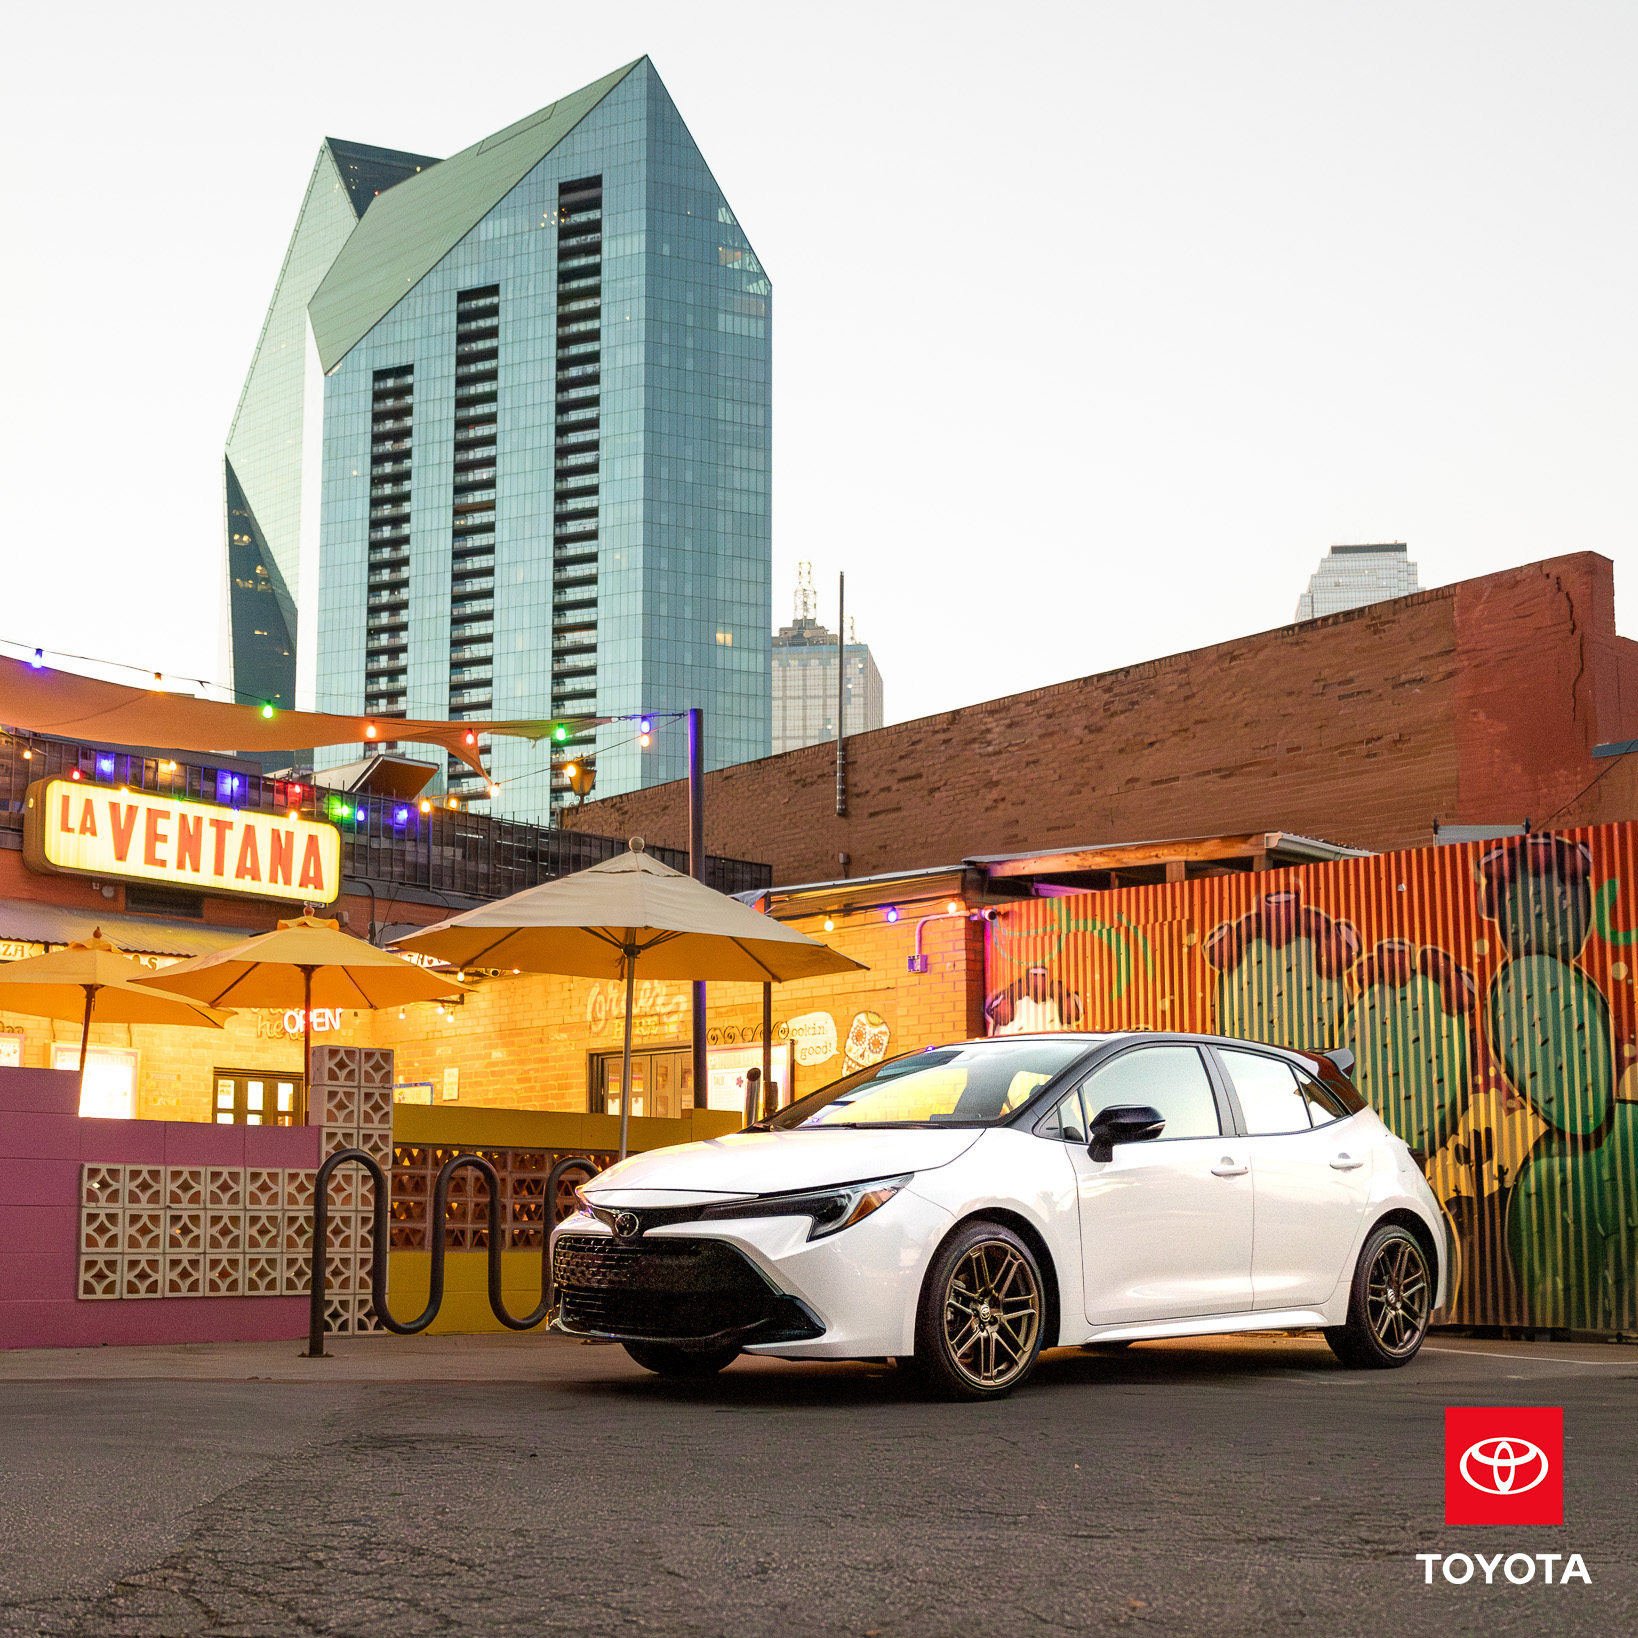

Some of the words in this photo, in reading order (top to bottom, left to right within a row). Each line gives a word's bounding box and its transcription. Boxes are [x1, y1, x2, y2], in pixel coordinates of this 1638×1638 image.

[59, 794, 98, 837] LA
[108, 801, 325, 891] VENTANA
[283, 1007, 344, 1034] OPEN
[800, 1041, 832, 1061] good!
